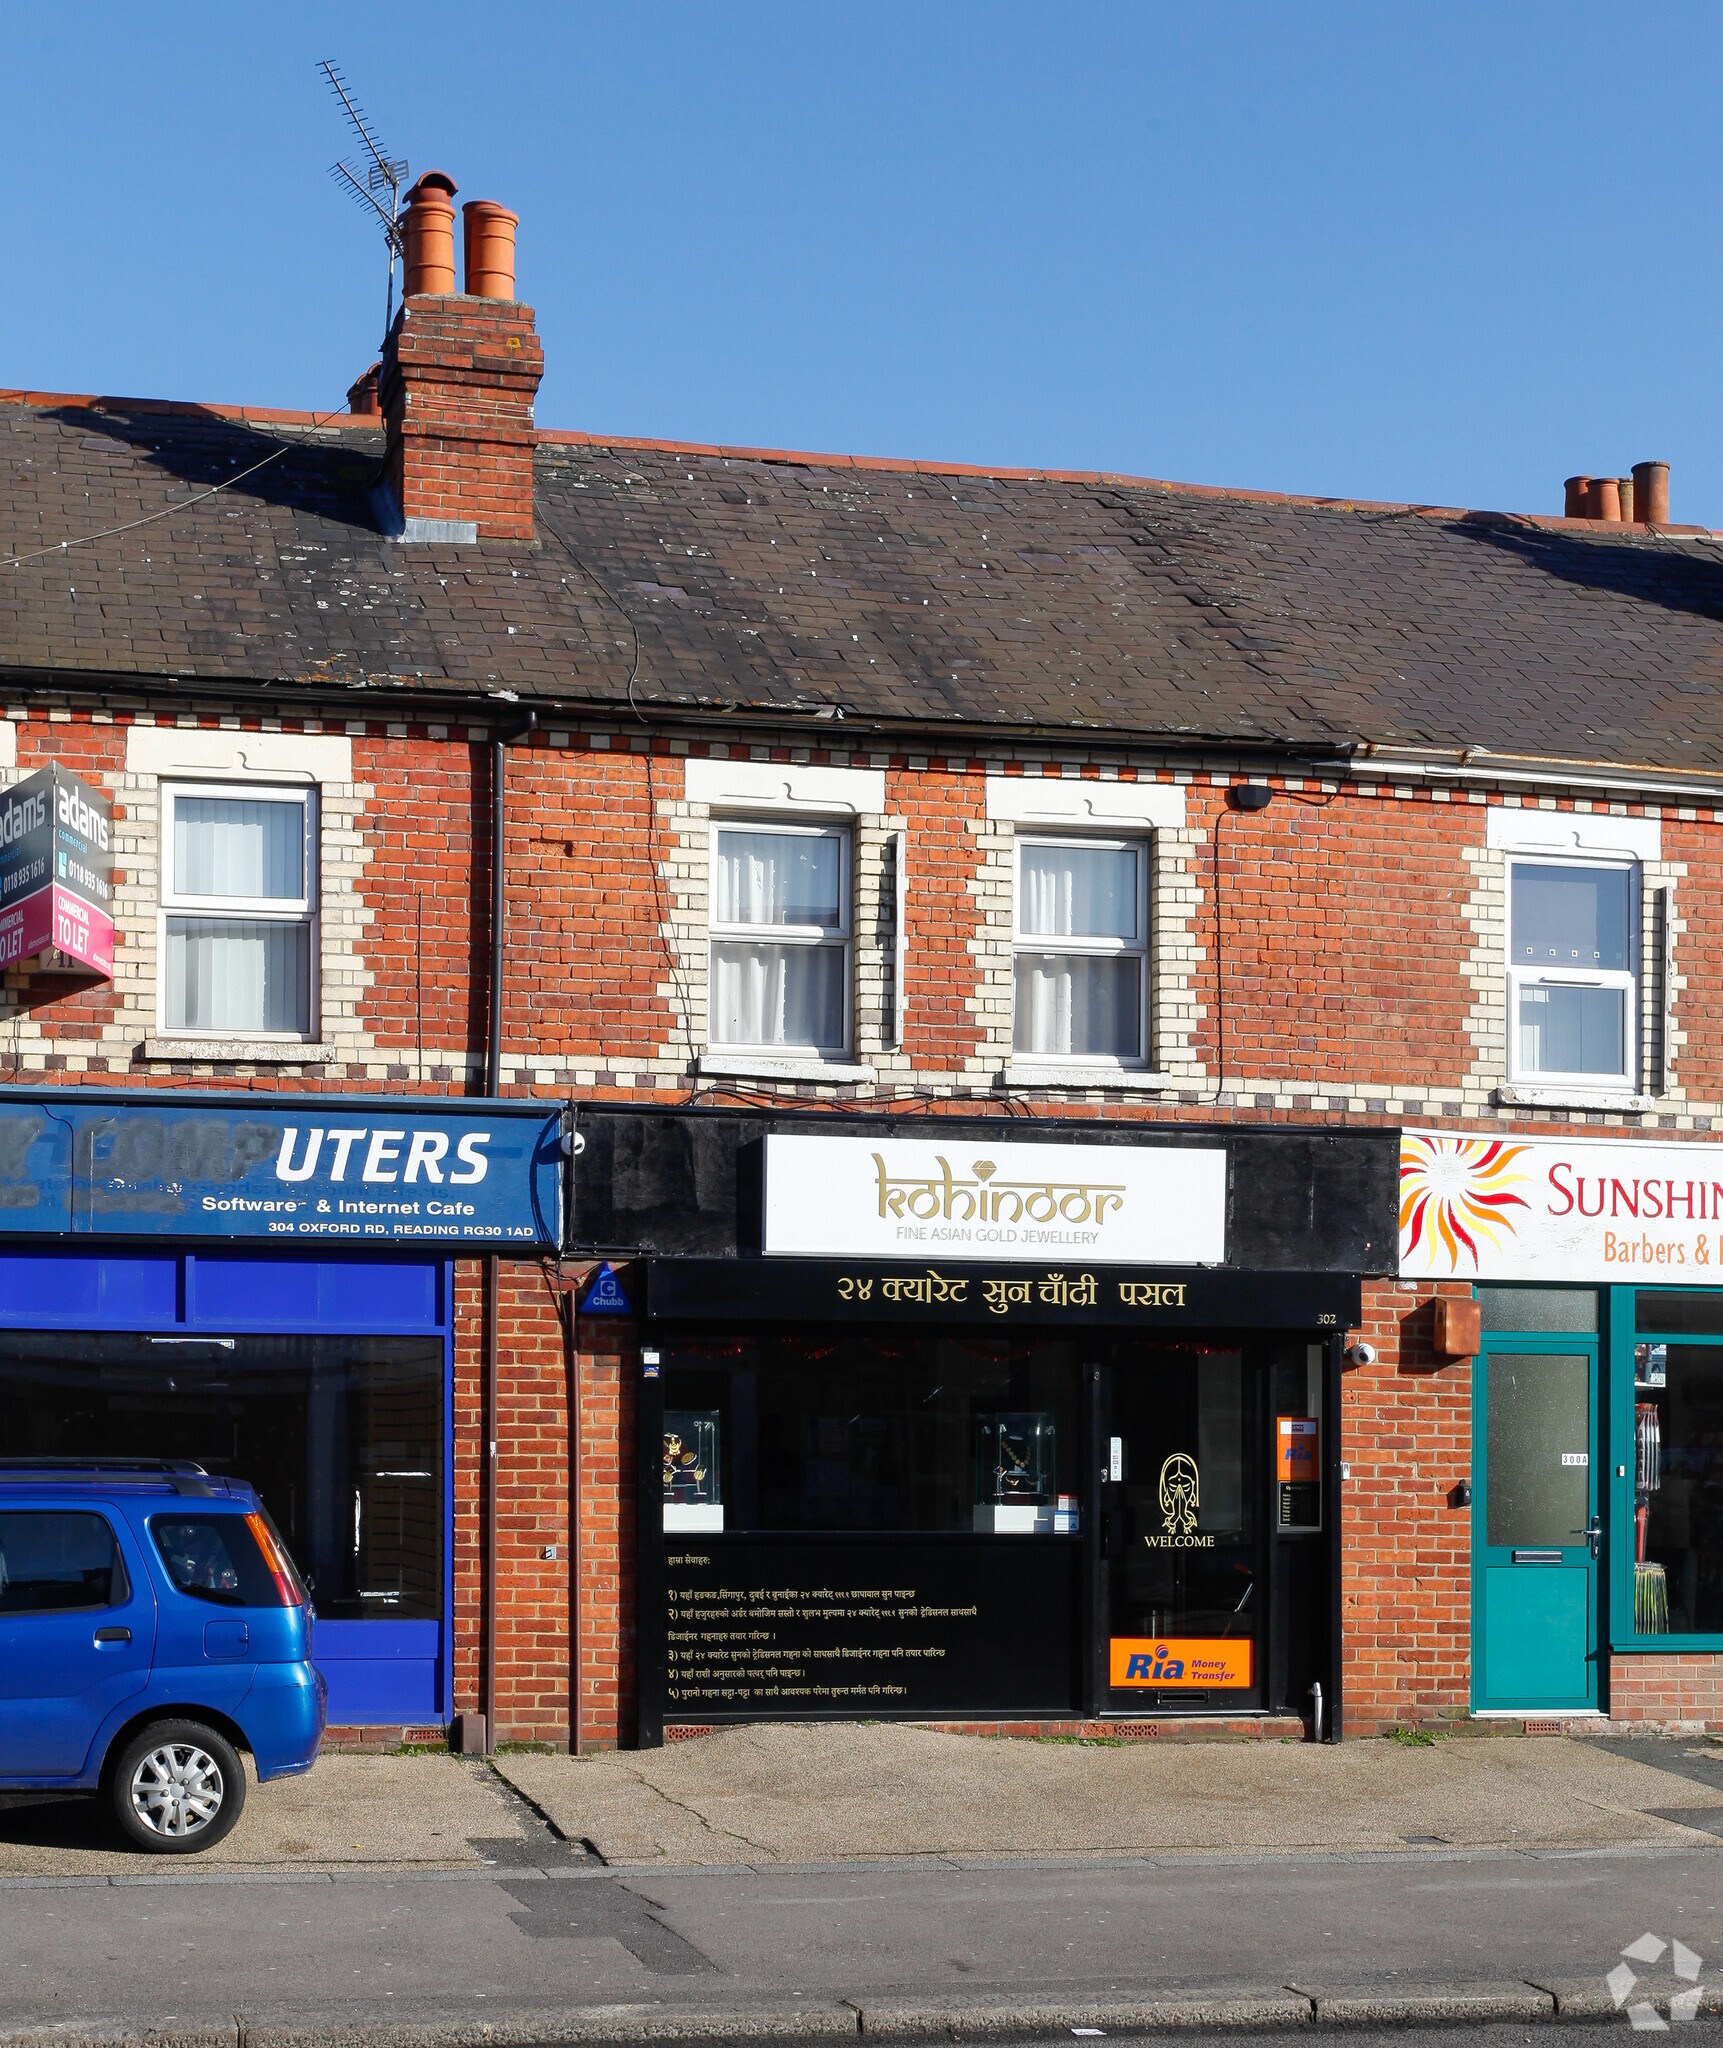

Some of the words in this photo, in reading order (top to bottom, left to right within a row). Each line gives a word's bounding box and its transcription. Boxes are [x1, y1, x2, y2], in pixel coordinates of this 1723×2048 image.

[59, 786, 109, 851] adams
[58, 829, 88, 854] commercial
[3, 870, 18, 894] 0118
[18, 865, 30, 887] 935
[31, 856, 45, 879] 1616
[68, 859, 84, 884] 0118
[84, 868, 96, 891] 935
[96, 876, 108, 900] 1616
[58, 896, 89, 926] COMMERCIAL
[7, 927, 24, 959] LET
[58, 914, 71, 946] TO
[72, 922, 90, 956] LET
[316, 1200, 331, 1213] &
[338, 1199, 420, 1215] Internet
[426, 1200, 475, 1216] Cafe
[268, 1222, 294, 1233] 304
[299, 1223, 362, 1234] OXFORD
[365, 1224, 389, 1236] RD,
[393, 1224, 459, 1236] READING
[463, 1225, 502, 1237] RG30
[506, 1226, 533, 1237] 1AD
[896, 1227, 927, 1240] FINE
[931, 1228, 972, 1241] ASIAN
[976, 1228, 1017, 1243] GOLD
[1021, 1230, 1099, 1244] JEWELLERY
[1604, 1231, 1685, 1265] Barbers
[1695, 1233, 1710, 1265] &
[593, 1296, 624, 1306] Chubb
[837, 1277, 873, 1300] २४
[982, 1280, 1033, 1314] सुन
[1118, 1283, 1187, 1306] पसल
[1317, 1314, 1337, 1324] 302
[1563, 1455, 1587, 1464] 300A
[1144, 1535, 1215, 1548] WELCOME
[800, 1592, 810, 1600] २४
[695, 1652, 705, 1660] २४
[1125, 1645, 1185, 1679] Ria
[1191, 1659, 1226, 1670] Money
[1191, 1671, 1235, 1681] Transfer
